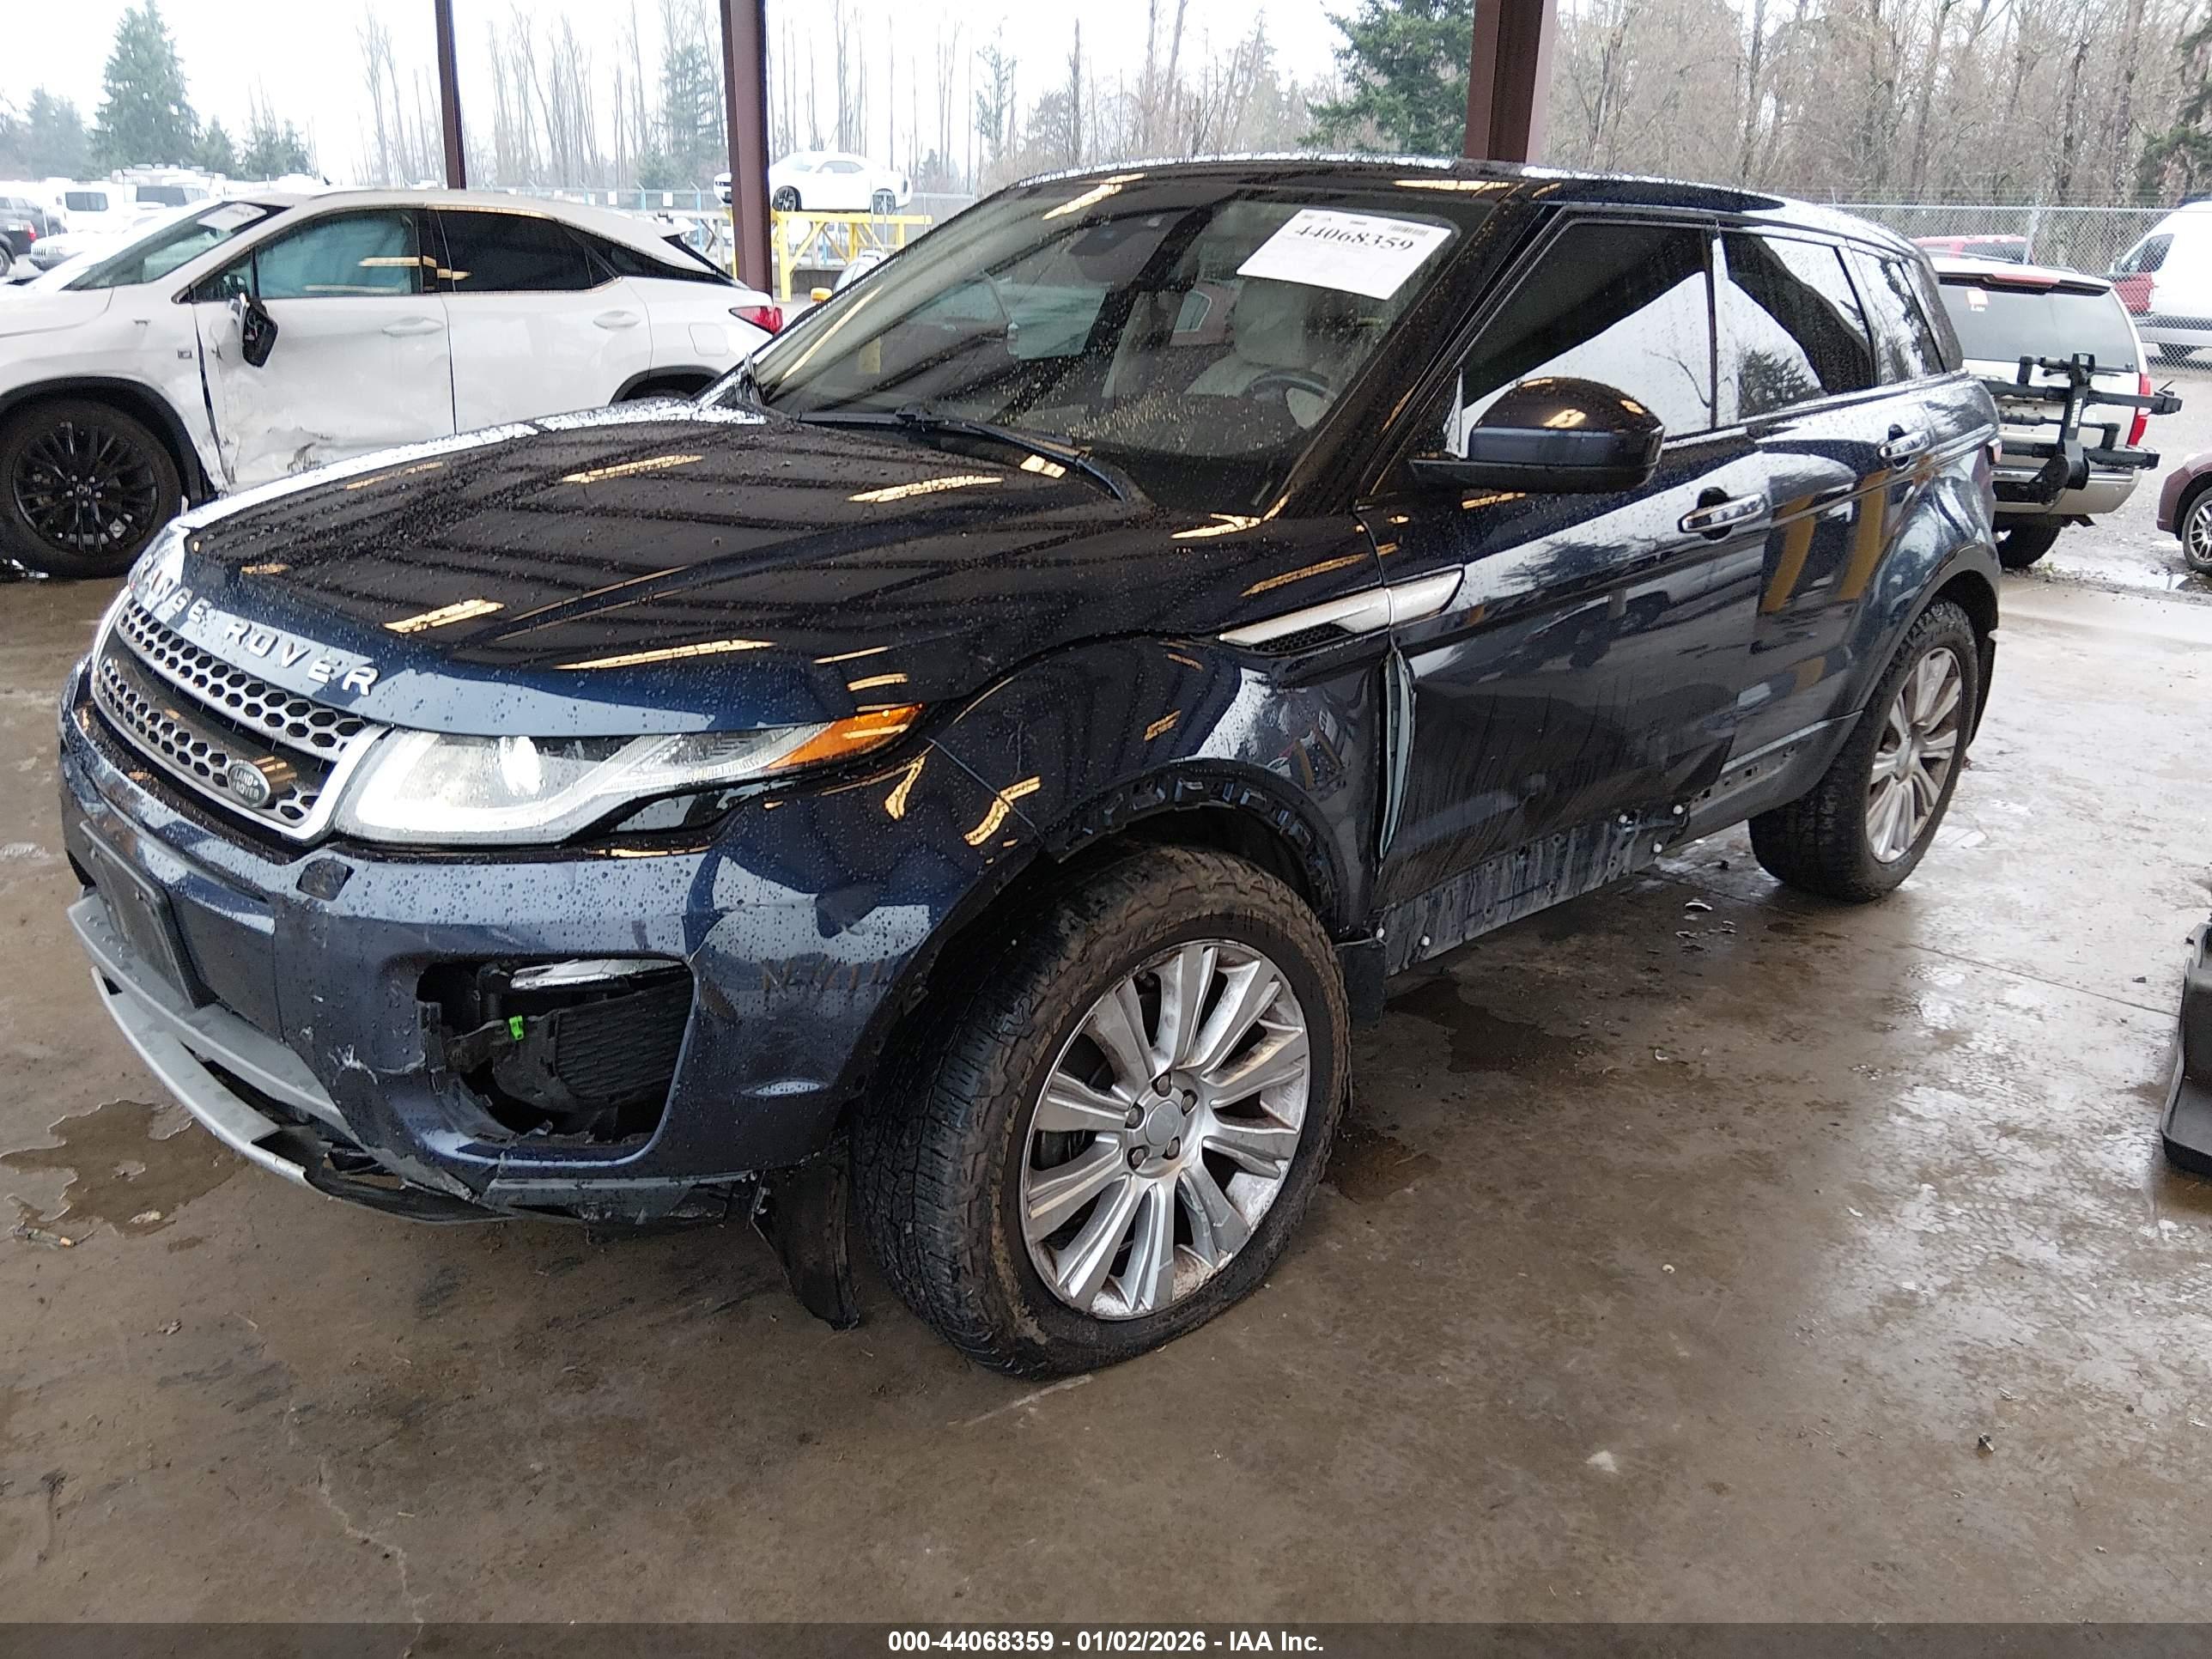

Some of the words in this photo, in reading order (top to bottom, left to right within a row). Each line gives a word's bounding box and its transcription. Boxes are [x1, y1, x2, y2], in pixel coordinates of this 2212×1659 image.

[1295, 225, 1414, 251] 44068359
[224, 619, 381, 696] ROVER
[234, 769, 254, 787] LAND
[235, 781, 260, 800] ROVER
